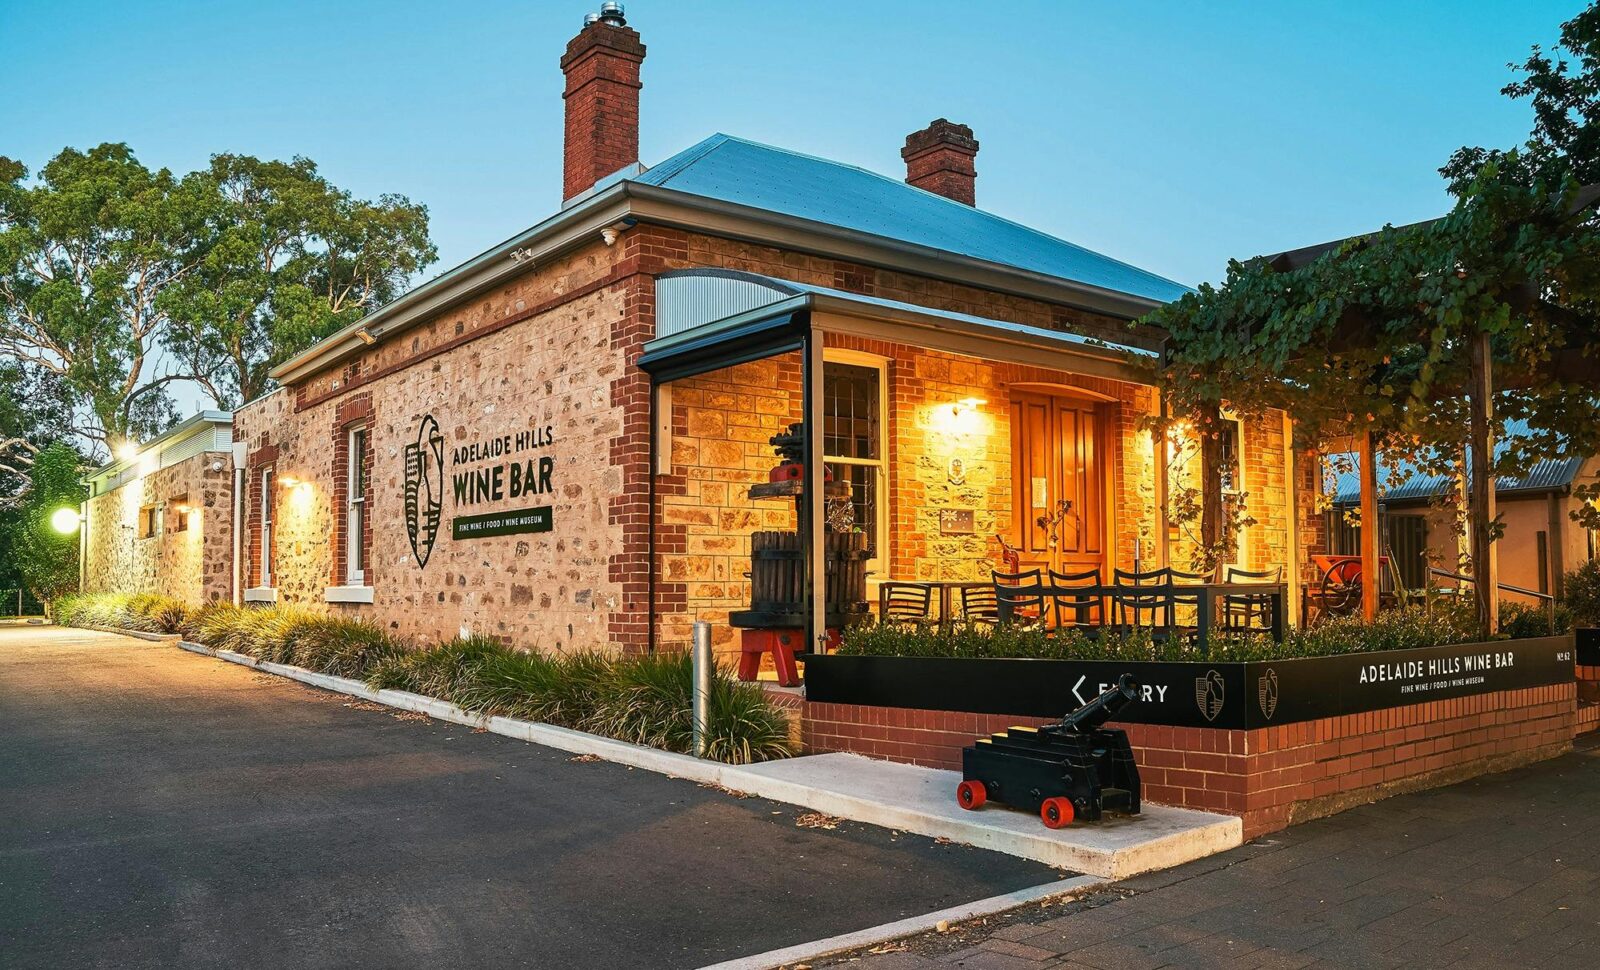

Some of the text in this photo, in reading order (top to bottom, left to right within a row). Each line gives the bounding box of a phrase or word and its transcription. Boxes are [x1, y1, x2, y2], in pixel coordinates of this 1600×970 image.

[453, 426, 553, 466] ADELAIDE HILLS
[453, 456, 553, 507] WINE BAR
[459, 524, 470, 532] FINE
[470, 522, 482, 530] WINE
[486, 520, 501, 528] FOOD
[505, 517, 519, 526] WINE
[519, 515, 542, 525] MUSEUM
[1564, 651, 1570, 661] 62
[1359, 651, 1514, 684] ADELAIDE HILLS WINE BAR
[1098, 682, 1168, 702] ERY
[1401, 684, 1414, 694] FINE
[1415, 682, 1429, 692] WINE
[1433, 680, 1448, 690] FOOD
[1452, 678, 1465, 687] WINE
[1465, 676, 1485, 685] MUSEUM
